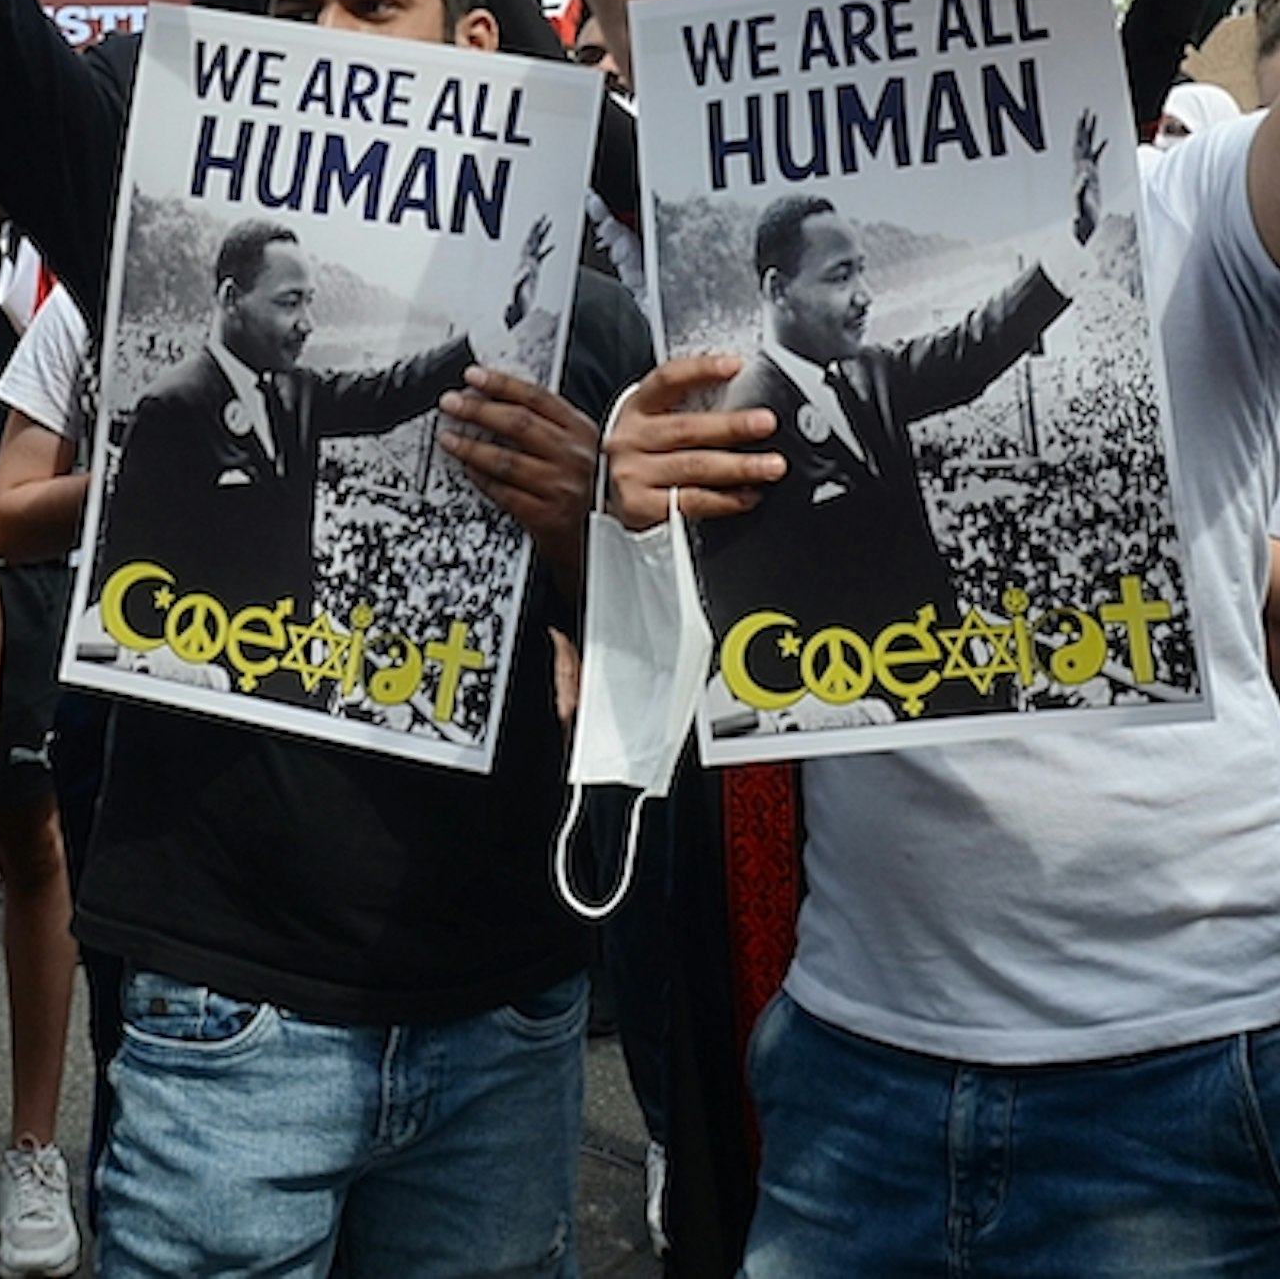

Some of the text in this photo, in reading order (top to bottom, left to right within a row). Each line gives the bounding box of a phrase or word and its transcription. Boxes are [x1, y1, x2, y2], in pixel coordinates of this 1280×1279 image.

[193, 40, 533, 146] WE ARE ALL
[682, 15, 780, 87] WE
[190, 115, 512, 240] HUMAN
[707, 57, 1047, 191] HUMAN
